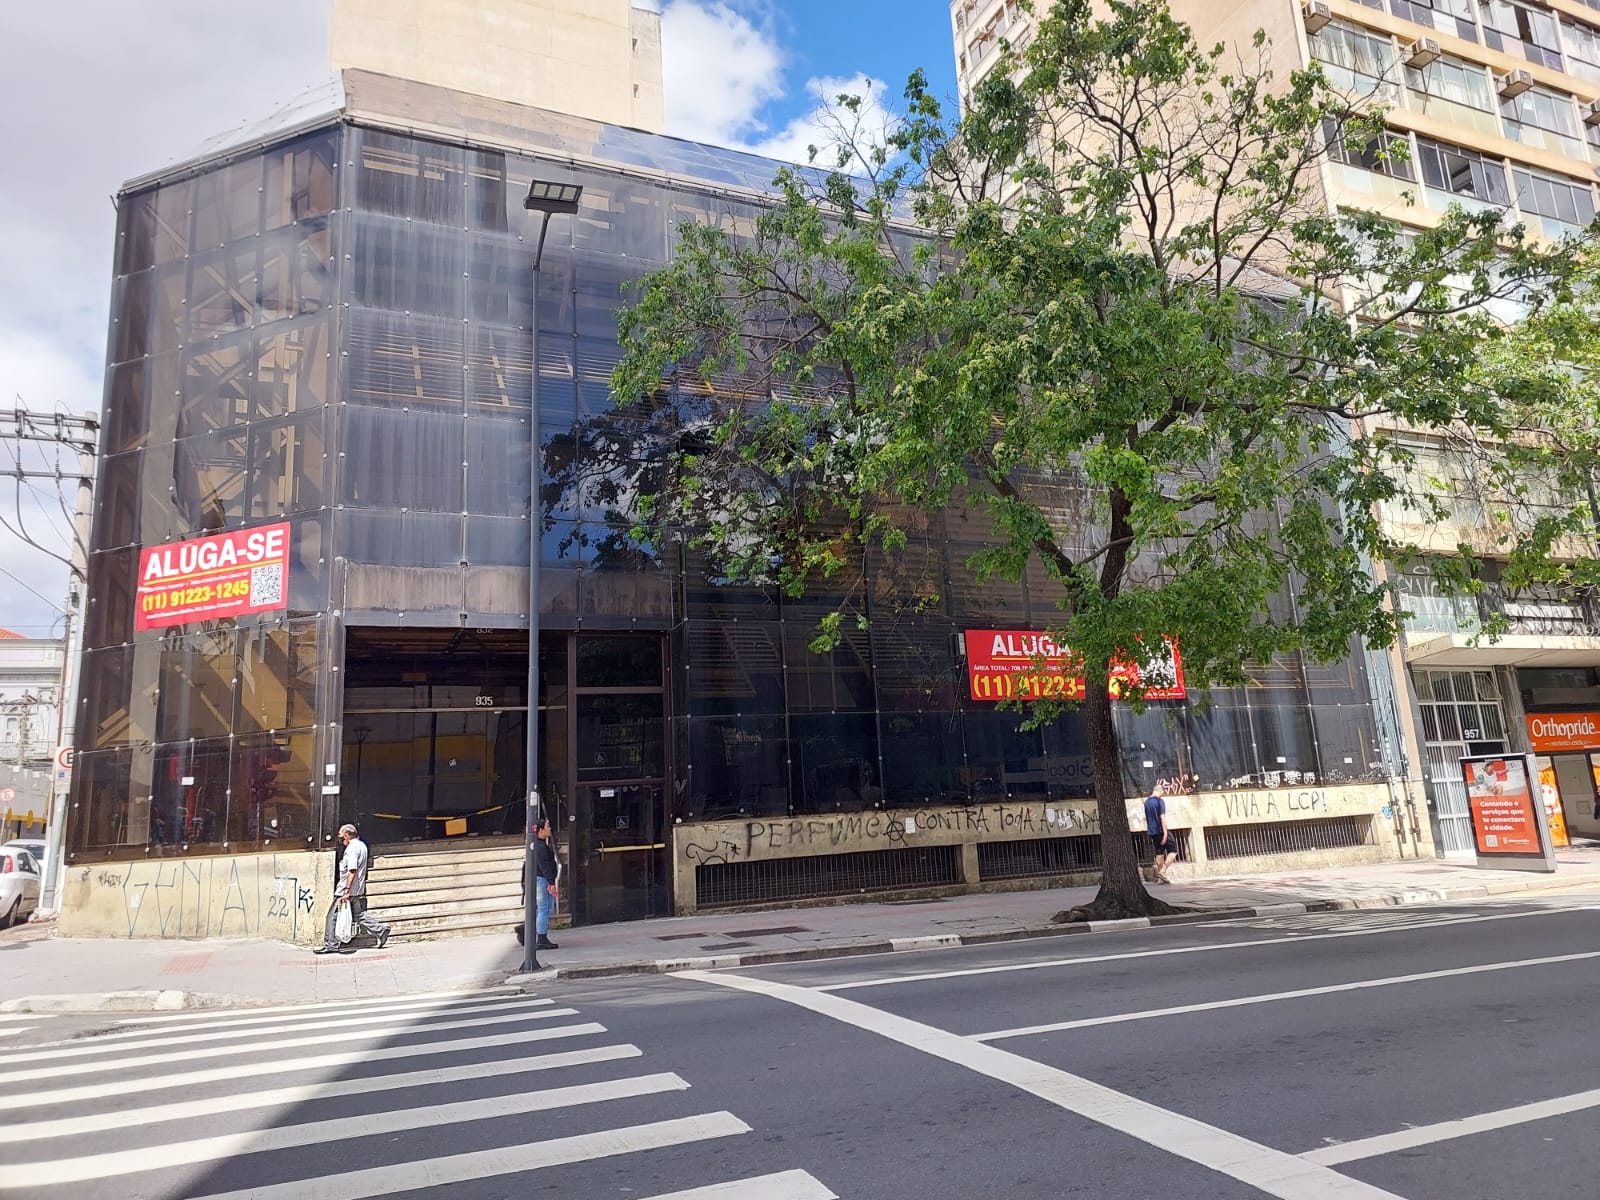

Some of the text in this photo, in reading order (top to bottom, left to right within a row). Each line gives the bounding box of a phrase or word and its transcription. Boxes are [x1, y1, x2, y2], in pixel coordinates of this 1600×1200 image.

[144, 529, 284, 580] ALUGA-SE
[143, 593, 167, 612] (11)
[170, 579, 249, 607] 91223-1245
[991, 634, 1072, 657] ALUGA
[973, 674, 1012, 697] (11)
[475, 695, 494, 706] 935
[1463, 728, 1480, 739] 957
[1531, 716, 1596, 740] Orthopride
[1221, 791, 1327, 818] VIVA A LCP!
[914, 807, 990, 833] CONTRA
[267, 895, 289, 918] 22
